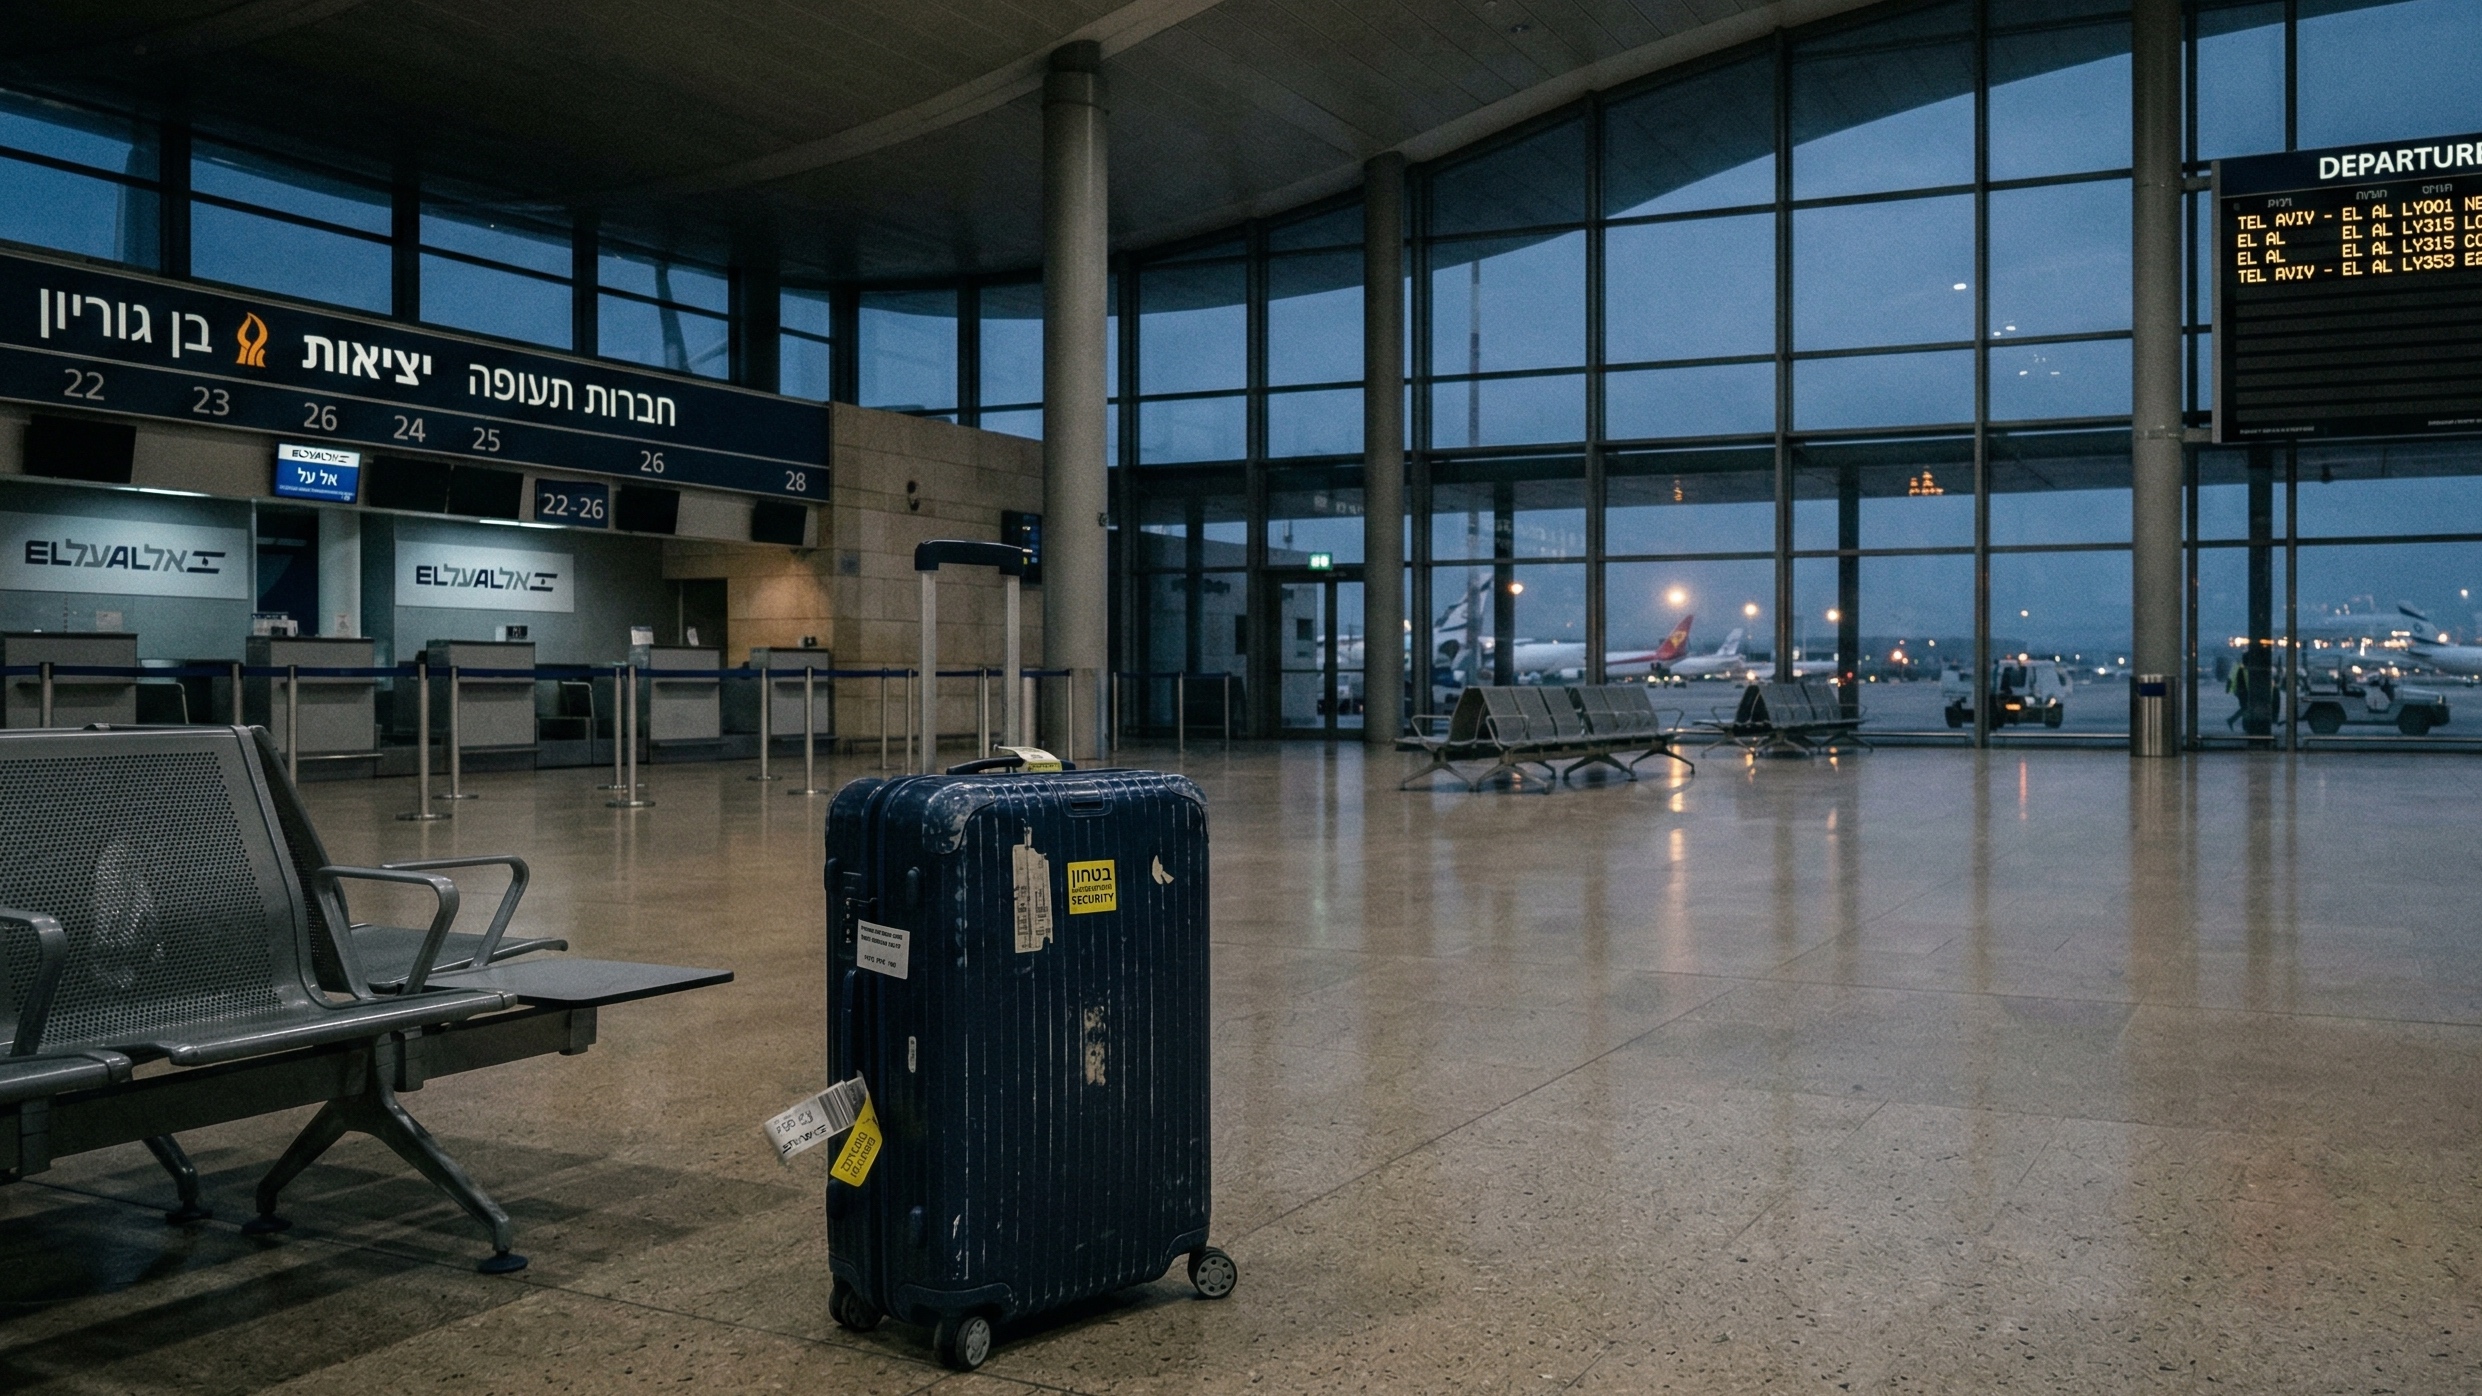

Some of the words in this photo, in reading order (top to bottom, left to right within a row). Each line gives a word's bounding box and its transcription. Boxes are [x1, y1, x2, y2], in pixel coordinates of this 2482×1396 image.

[2238, 216, 2267, 230] TEL
[2275, 210, 2315, 227] AVIV
[2342, 207, 2363, 221] EL
[2372, 204, 2393, 219] AL
[2402, 198, 2453, 216] LY001
[2237, 234, 2257, 248] EL
[2266, 231, 2286, 245] AL
[2342, 225, 2363, 240] EL
[2372, 222, 2393, 237] AL
[2402, 216, 2455, 235] LY315
[2237, 252, 2257, 266] EL
[2266, 249, 2286, 263] AL
[2342, 243, 2363, 258] EL
[2372, 240, 2393, 256] AL
[2402, 235, 2455, 253] LY315
[2238, 269, 2267, 283] TEL
[2275, 264, 2315, 281] AVIV
[2342, 261, 2363, 276] EL
[2372, 258, 2393, 274] AL
[2402, 253, 2455, 272] LY353
[40, 288, 152, 343] גוריון
[171, 311, 213, 359] בן
[302, 335, 432, 386] יציאות
[469, 363, 574, 411] תעופה
[584, 384, 676, 427] חברות
[64, 368, 105, 401] 22
[192, 386, 231, 416] 23
[303, 402, 337, 431] 26
[393, 414, 426, 443] 24
[472, 427, 501, 452] 25
[640, 450, 665, 474] 26
[785, 470, 806, 492] 28
[297, 467, 316, 485] על
[320, 469, 338, 486] אל
[542, 493, 604, 520] 22-26
[1071, 867, 1112, 888] בטחון
[1071, 893, 1114, 906] SECURITY
